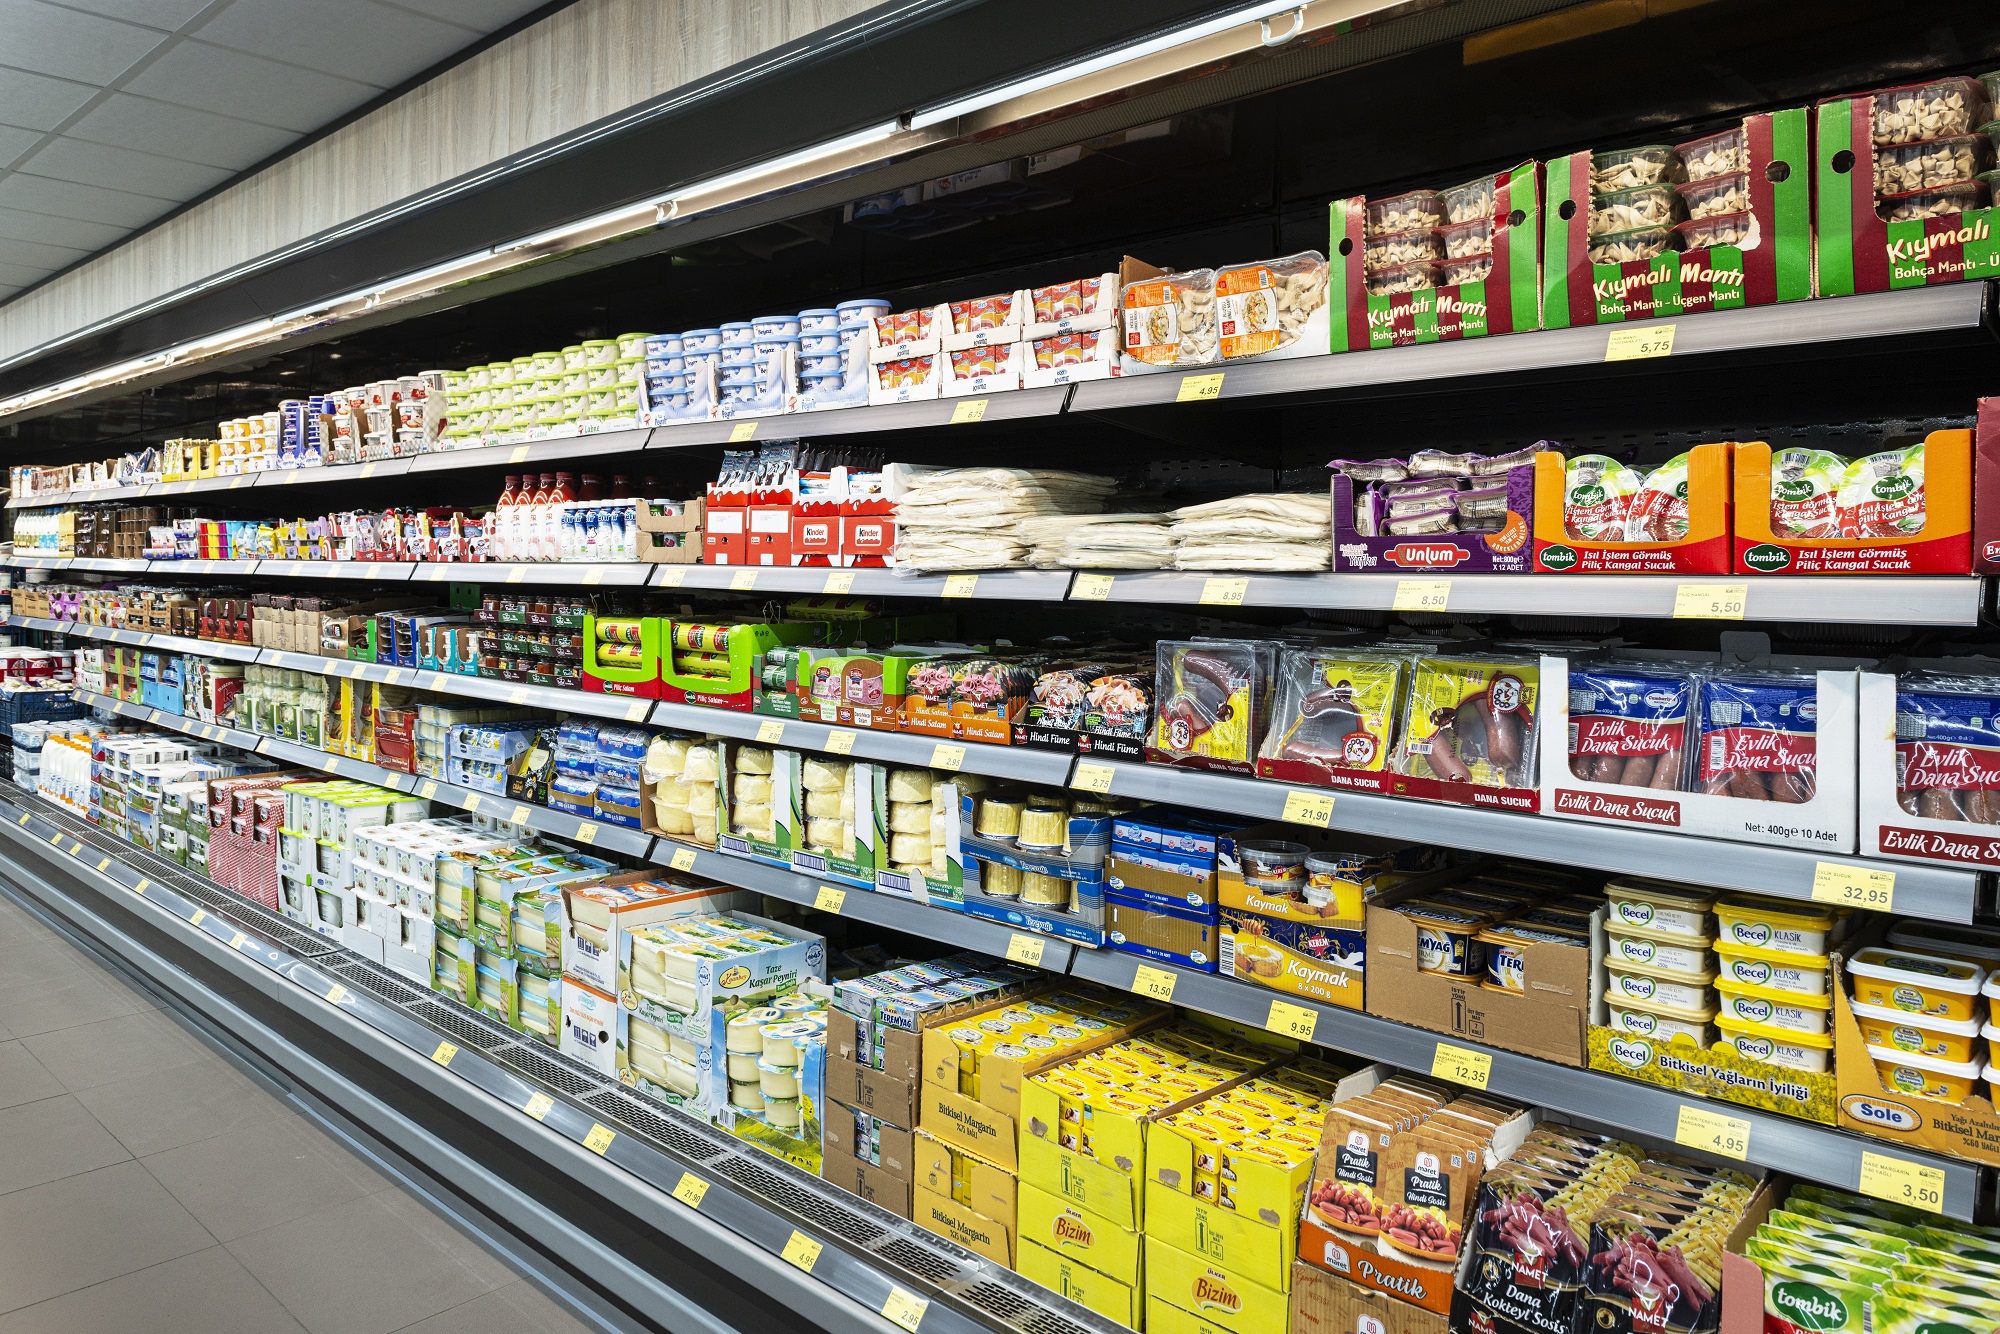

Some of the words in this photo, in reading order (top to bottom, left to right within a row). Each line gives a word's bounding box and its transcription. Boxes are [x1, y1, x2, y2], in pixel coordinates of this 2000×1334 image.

[1886, 219, 1990, 266] Kıymalı
[1895, 266, 1935, 279] Bohça
[1939, 259, 1976, 273] Mantı
[1593, 264, 1672, 302] Kıymalı
[1680, 263, 1744, 287] Mantı
[1601, 302, 1631, 314] Bohça
[1633, 298, 1662, 310] Mantı
[1673, 293, 1706, 308] Üçgen
[1709, 289, 1740, 302] Mantı
[1367, 296, 1430, 330] Kıymalı
[1436, 295, 1487, 317] Mantı
[1373, 331, 1397, 340] Bohça
[1400, 327, 1422, 337] Mantı
[1431, 322, 1457, 335] Üçgen
[1459, 320, 1484, 330] Mantı
[1641, 341, 1669, 353] 5,75
[1875, 479, 1912, 494] tombik
[1406, 548, 1454, 564] Unlum
[1542, 553, 1575, 562] tombik
[1584, 551, 1599, 559] Isıl
[1602, 550, 1629, 561] İşlem
[1632, 551, 1672, 562] Görmüş
[1749, 552, 1788, 563] tombik
[1799, 550, 1818, 559] Isıl
[1822, 548, 1855, 560] İşlem
[1859, 549, 1907, 560] Görmüş
[1582, 561, 1602, 570] Piliç
[1605, 561, 1641, 571] Kangal
[1644, 561, 1675, 570] Sucuk
[1796, 560, 1820, 570] Piliç
[1824, 560, 1868, 570] Kangal
[1872, 560, 1911, 569] Sucuk
[1222, 591, 1242, 601] 8,95
[1421, 596, 1445, 606] 8,50
[1710, 601, 1742, 614] 5,50
[923, 694, 939, 702] NAMET
[911, 717, 926, 728] Hindi
[927, 719, 947, 729] Salam
[1589, 720, 1627, 737] Evlik
[966, 726, 983, 737] Hindi
[984, 729, 1005, 739] Salam
[1029, 732, 1049, 742] Hindi
[1050, 735, 1071, 745] Füme
[1094, 740, 1115, 754] Hindi
[1116, 743, 1139, 755] Füme
[1581, 737, 1619, 755] Dana
[1622, 734, 1672, 751] Sucuk
[1735, 734, 1780, 751] Evlik
[1092, 779, 1109, 789] 2,75
[1331, 775, 1353, 785] DANA
[1354, 777, 1381, 789] SUCUK
[1474, 793, 1499, 805] DANA
[1501, 795, 1532, 808] SUCUK
[1558, 793, 1591, 812] Evlik
[1593, 796, 1630, 817] Dana
[1632, 801, 1677, 822] Sucuk
[1302, 809, 1328, 821] 21,90
[1745, 823, 1765, 832] Net:
[1801, 829, 1812, 838] 10
[1815, 830, 1837, 842] Adet
[1883, 830, 1929, 854] Evlik
[1931, 835, 1981, 860] Dana
[1843, 886, 1888, 904] 32,95
[1245, 894, 1288, 913] Kaymak
[1622, 906, 1650, 920] Becel
[1736, 926, 1767, 941] Becel
[1774, 929, 1801, 943] KLASİK
[1308, 938, 1329, 948] KEREM
[1021, 950, 1040, 960] 18,90
[1624, 944, 1651, 958] Becel
[766, 964, 782, 974] Taze
[1287, 960, 1350, 988] Kaymak
[1736, 965, 1767, 979] Becel
[1773, 968, 1801, 982] KLASİK
[749, 976, 771, 989] Kaşar
[774, 969, 798, 983] Peyniri
[1149, 983, 1171, 997] 13,50
[1298, 982, 1302, 990] 8
[1311, 985, 1325, 995] 200
[1326, 990, 1331, 999] g
[1625, 980, 1652, 994] Becel
[1738, 1002, 1768, 1017] Becel
[1775, 1007, 1803, 1020] KLASİK
[1290, 1022, 1312, 1036] 9,95
[1626, 1016, 1653, 1030] Becel
[1615, 1044, 1646, 1062] Becel
[1738, 1040, 1769, 1055] Becel
[1776, 1045, 1804, 1059] KLASİK
[1455, 1066, 1485, 1083] 12,35
[1660, 1055, 1707, 1076] Bitkisel
[1711, 1066, 1766, 1091] Yağların
[1770, 1078, 1809, 1101] İyiliği
[938, 1102, 962, 1121] Bitkisel
[964, 1113, 997, 1137] Margarin
[1861, 1102, 1902, 1123] Sole
[1349, 1143, 1366, 1153] maret
[1713, 1135, 1743, 1152] 4,95
[1963, 1137, 1979, 1148] %60
[1982, 1141, 1999, 1152] YAĞLI
[1342, 1153, 1371, 1169] Pratik
[1337, 1167, 1355, 1180] Hindi
[1356, 1171, 1374, 1184] Sosis
[1417, 1165, 1437, 1176] maret
[1410, 1176, 1443, 1191] Pratik
[683, 1189, 701, 1203] 21,90
[1406, 1191, 1427, 1203] Hindi
[1427, 1195, 1446, 1207] Sosis
[1903, 1184, 1938, 1204] 3,50
[932, 1208, 956, 1227] Bitkisel
[957, 1220, 990, 1245] Margarin
[1056, 1217, 1091, 1246] Bizim
[798, 1253, 814, 1267] 4,95
[1326, 1257, 1347, 1270] maret
[1206, 1268, 1226, 1280] ÜLKER
[1511, 1261, 1548, 1283] NAMET
[1357, 1259, 1427, 1301] Pratik
[1196, 1276, 1237, 1309] Bizim
[1505, 1284, 1542, 1309] Dana
[1777, 1287, 1843, 1322] tombik
[901, 1311, 919, 1326] 2,95
[1482, 1291, 1531, 1321] Kokteyl
[1531, 1310, 1567, 1334] Sosis
[1628, 1306, 1668, 1328] NAMET
